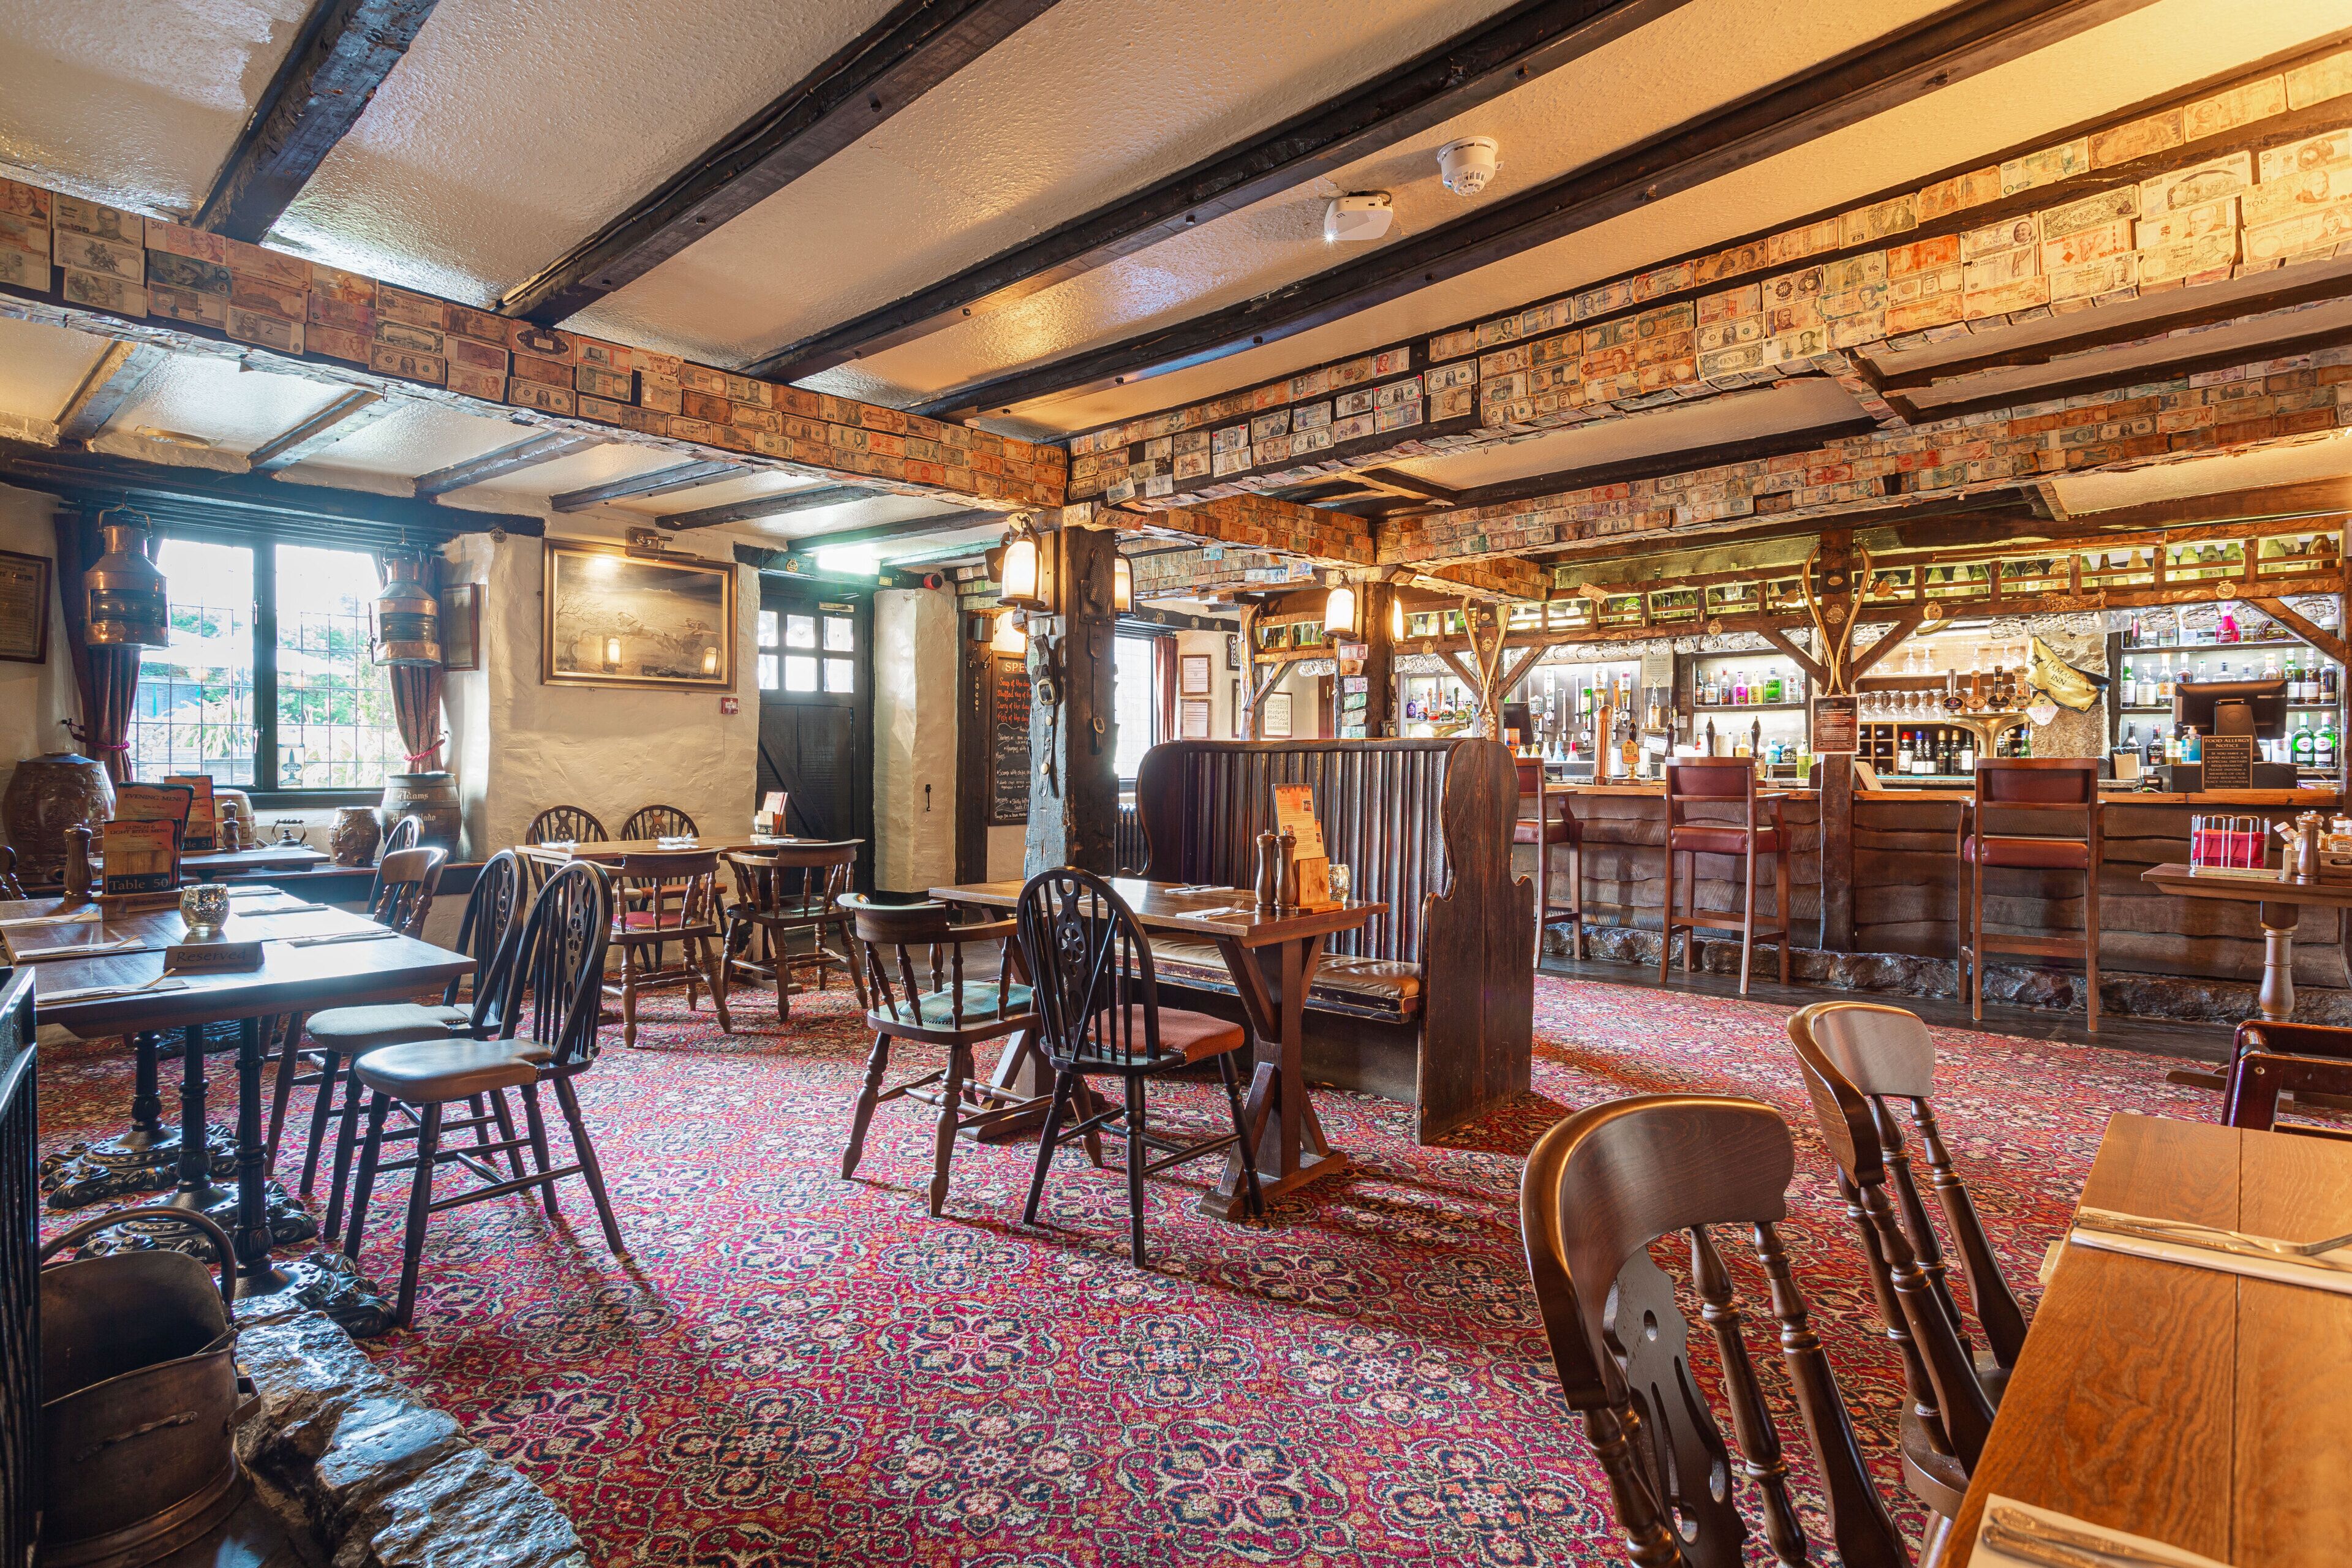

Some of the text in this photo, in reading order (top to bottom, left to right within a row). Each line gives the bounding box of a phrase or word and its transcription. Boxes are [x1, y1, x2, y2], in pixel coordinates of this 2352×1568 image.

[2246, 198, 2268, 209] 500
[151, 221, 164, 230] 50
[2161, 225, 2171, 236] 20
[1983, 236, 2013, 247] CANADA
[2046, 237, 2066, 246] 10000
[214, 267, 229, 281] 10
[1779, 285, 1788, 295] 50
[265, 323, 274, 335] 2
[1719, 356, 1741, 366] ONE
[2045, 660, 2082, 685] JAMAICA
[999, 677, 1010, 689] Soup
[2051, 674, 2067, 685] INN
[997, 689, 1014, 701] Stuffed
[997, 702, 1009, 714] Curry
[398, 790, 429, 801] Adams
[109, 878, 168, 891] Table 50
[176, 949, 246, 963] Reserved
